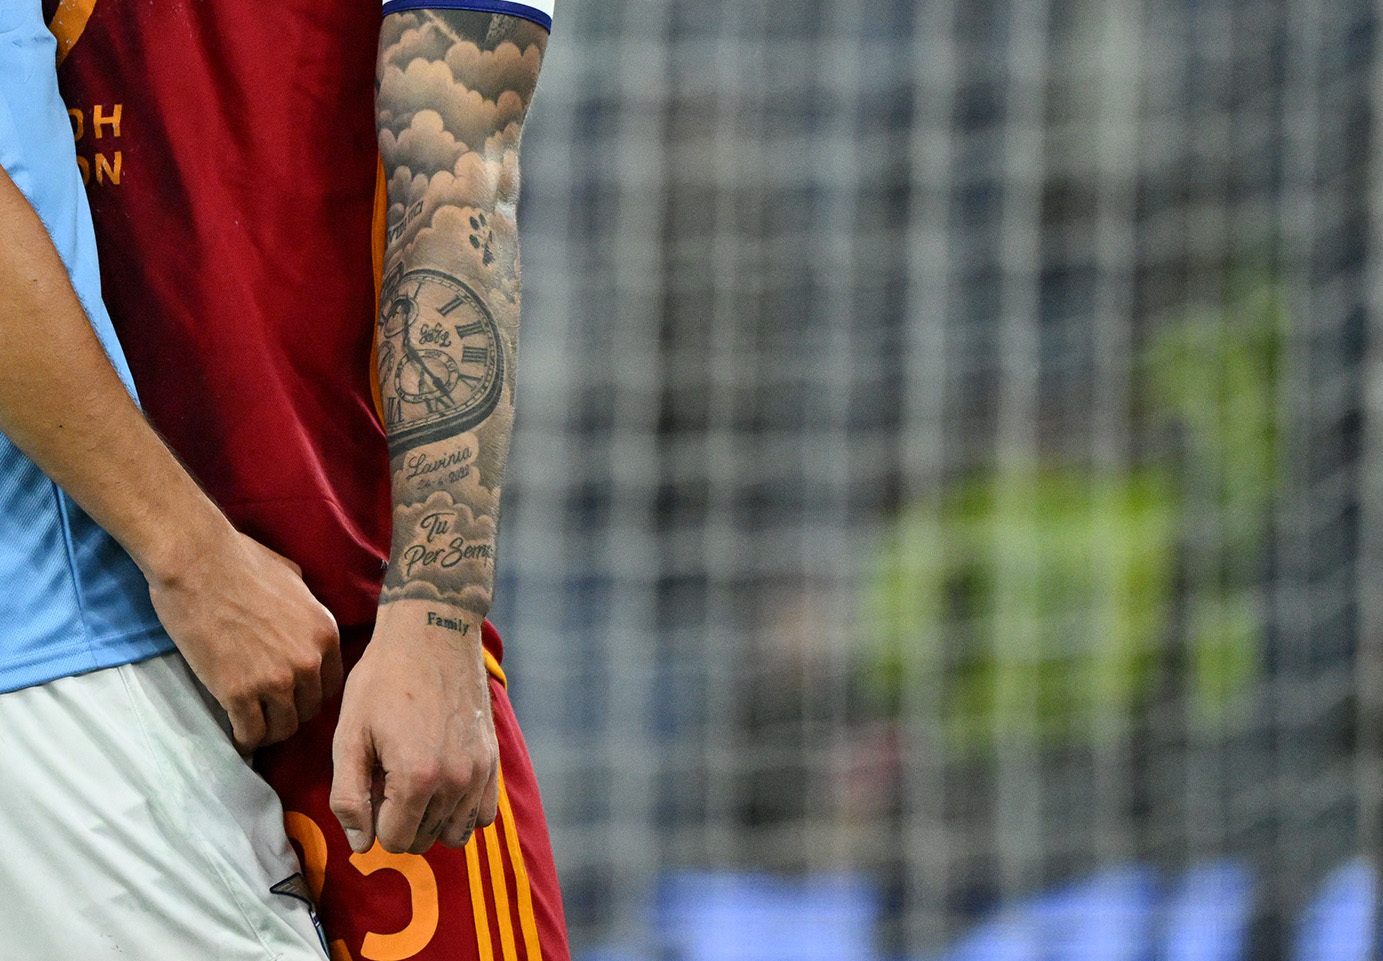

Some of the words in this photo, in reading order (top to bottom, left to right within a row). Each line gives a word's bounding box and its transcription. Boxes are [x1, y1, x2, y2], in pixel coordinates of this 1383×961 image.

[405, 447, 474, 480] Lavinia
[420, 511, 456, 543] Tu
[404, 544, 446, 577] Per
[427, 611, 470, 637] Family
